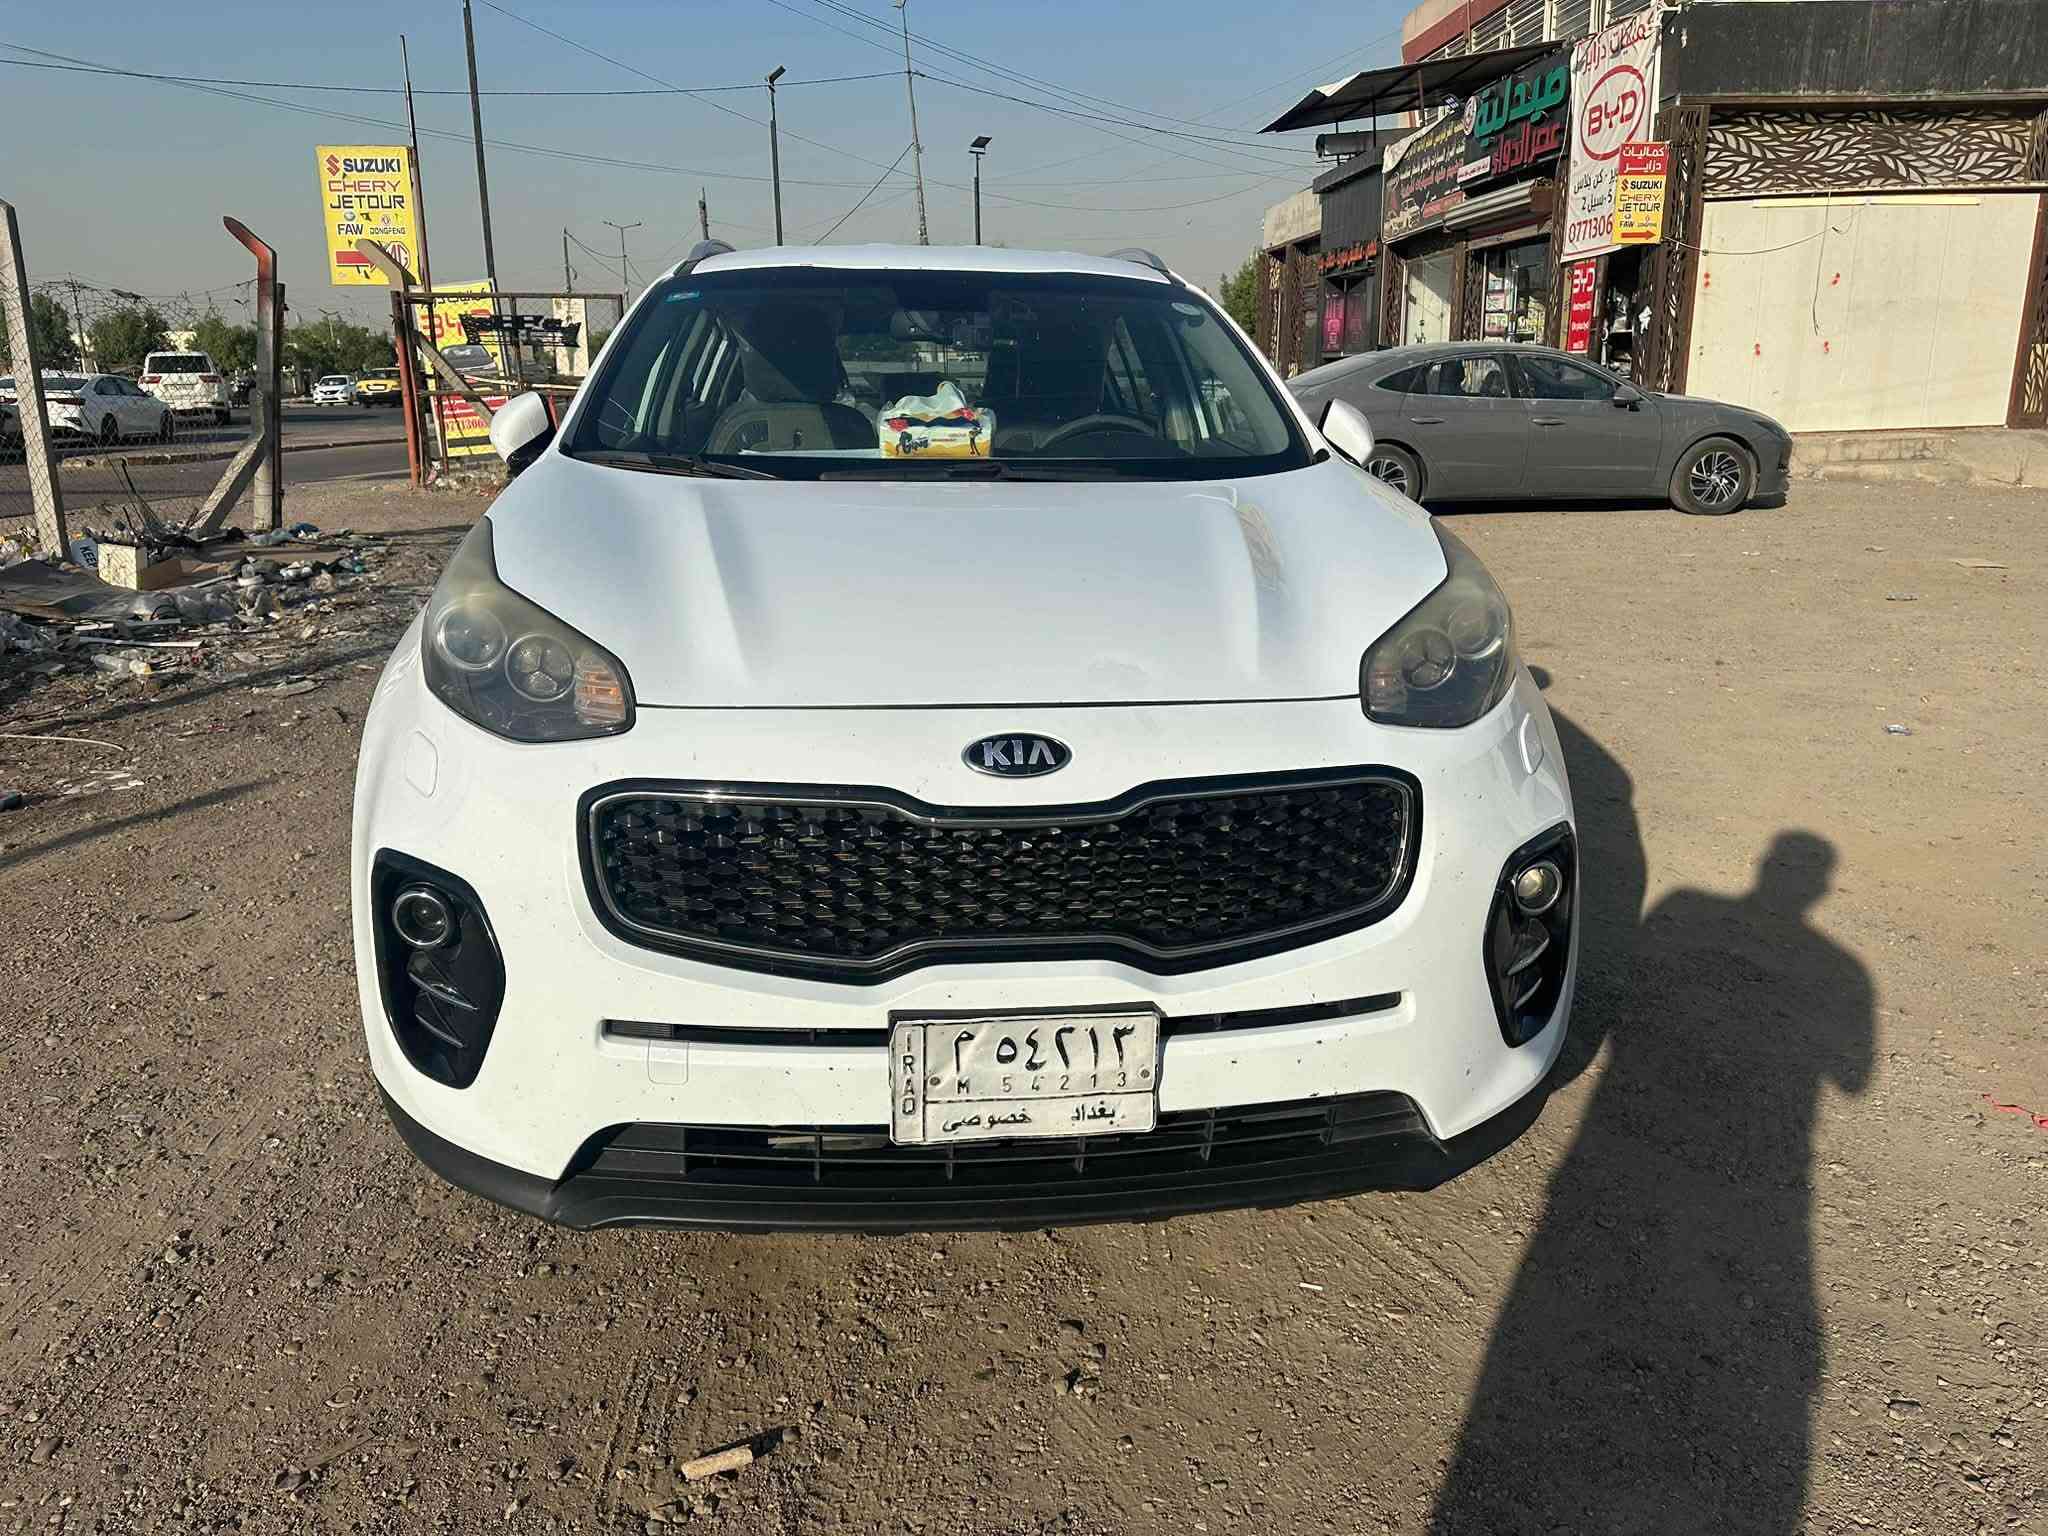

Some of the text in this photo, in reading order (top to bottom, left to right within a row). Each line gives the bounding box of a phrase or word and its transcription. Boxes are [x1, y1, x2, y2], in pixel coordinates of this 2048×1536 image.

[1474, 65, 1569, 147] صيدلية
[1588, 90, 1637, 136] BYD
[1623, 145, 1665, 159] كماليات
[343, 158, 401, 173] SUZUKI
[328, 180, 401, 192] CHERY
[1630, 180, 1663, 190] SUZUKI
[329, 195, 405, 209] JETOUR
[1618, 203, 1661, 212] JETOUR
[337, 223, 406, 235] FAW DONGFENG
[1572, 268, 1595, 294] BYD
[981, 740, 1056, 766] KIA
[995, 1023, 1136, 1072] ٥٤٢١٣
[901, 1032, 916, 1116] IRAQ
[956, 1071, 1127, 1094] M 54213
[942, 1100, 1116, 1133] بغداد خصوصي
